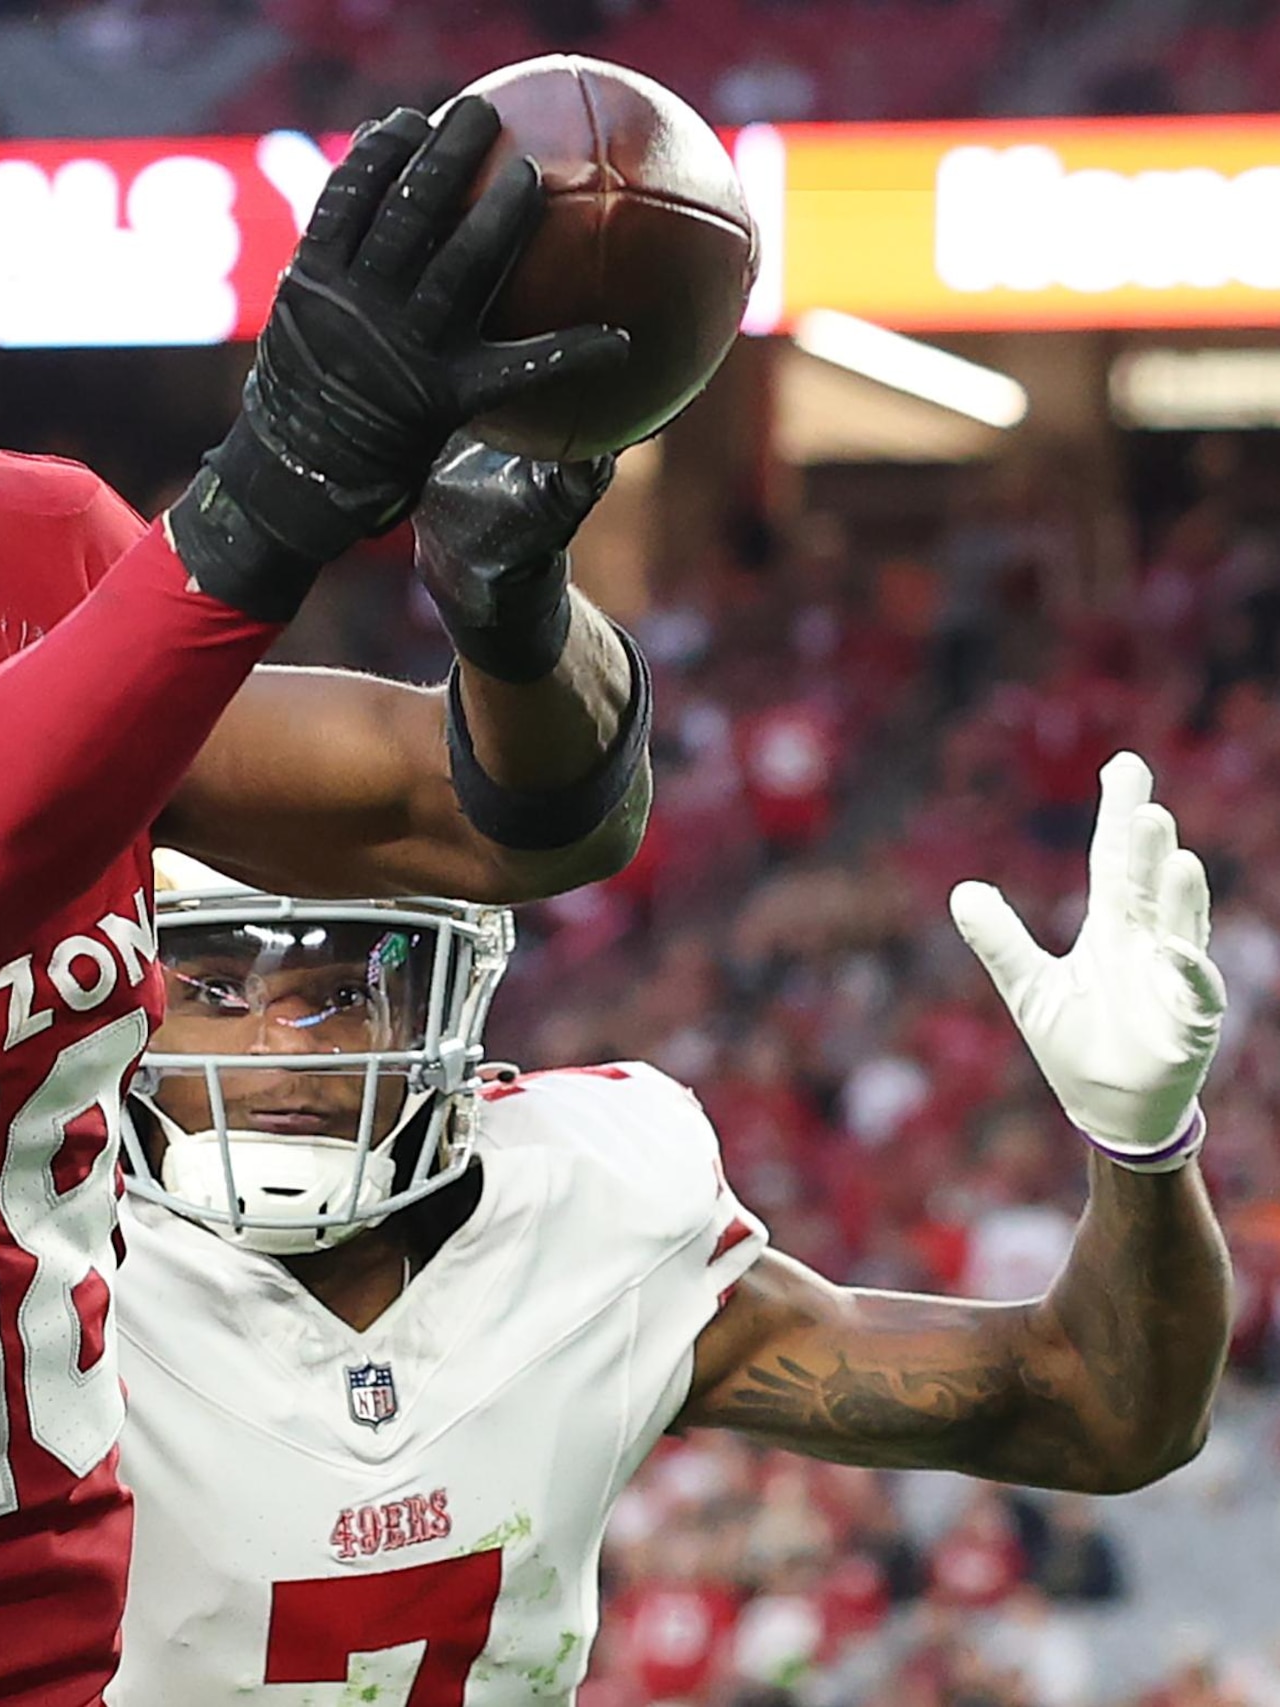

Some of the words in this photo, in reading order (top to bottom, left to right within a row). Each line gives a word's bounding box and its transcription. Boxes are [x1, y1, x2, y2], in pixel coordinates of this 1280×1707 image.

[356, 1386, 395, 1418] NFL
[330, 1487, 452, 1558] 49ERS
[264, 1547, 503, 1707] 7
